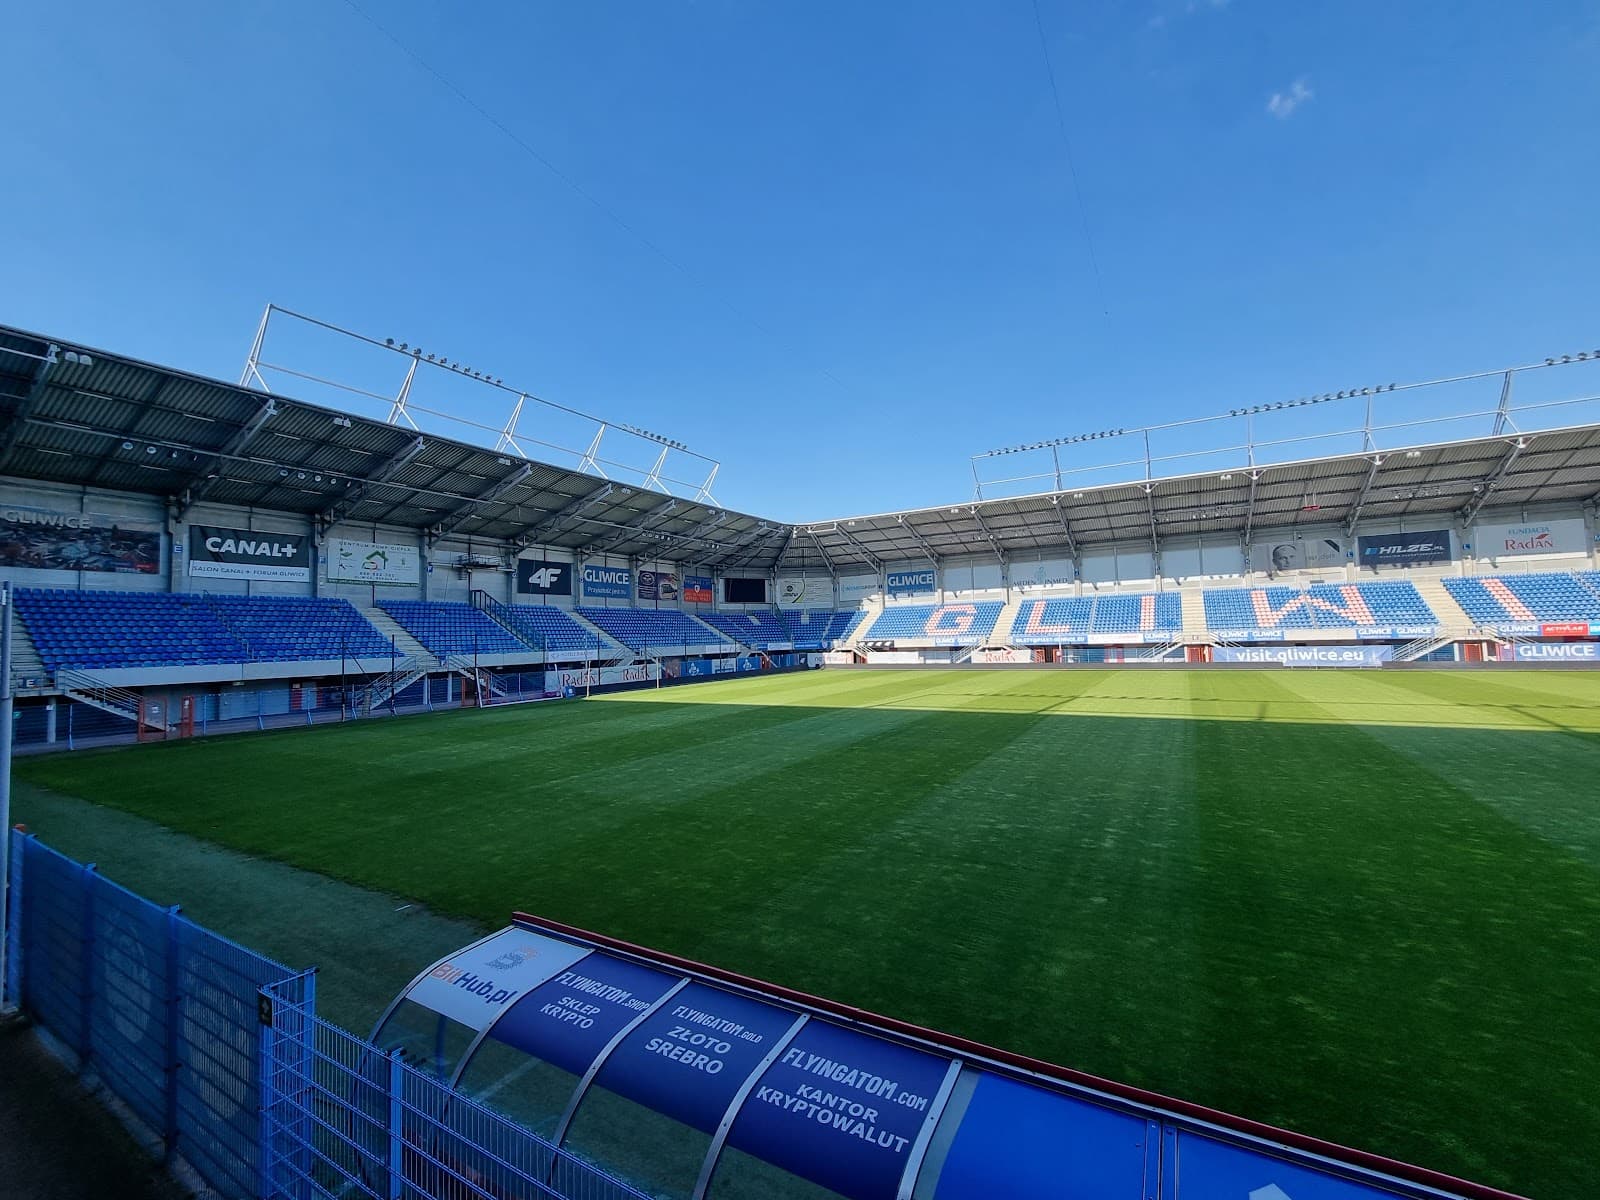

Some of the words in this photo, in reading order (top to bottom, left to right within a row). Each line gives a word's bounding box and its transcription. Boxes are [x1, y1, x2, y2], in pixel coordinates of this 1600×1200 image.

[5, 510, 92, 529] GLIWICE
[1508, 526, 1551, 535] FUNDACJA
[205, 536, 297, 558] CANAL+
[192, 565, 219, 573] SALON
[528, 567, 562, 588] 4F
[584, 569, 630, 585] GLIWICE
[888, 573, 933, 587] GLIWICE
[1396, 627, 1432, 635] GLIWICE
[1499, 624, 1539, 632] GLIWICE
[1236, 647, 1364, 663] visit.gliwice.eu
[1519, 645, 1595, 657] GLIWICE
[431, 963, 519, 1006] BitHub.pl
[554, 971, 651, 1012] FLYINGATOM.SHOP
[539, 1003, 595, 1030] KRYPTO
[557, 996, 601, 1016] SKLEP
[671, 1005, 763, 1044] FLYINGATOM.GOLD
[666, 1025, 732, 1054] ZŁOTO
[644, 1037, 724, 1074] SREBRO
[781, 1047, 928, 1112] FLYINGATOM.COM
[795, 1083, 879, 1124] KANTOR
[755, 1085, 910, 1153] KRYPTOWALUT
